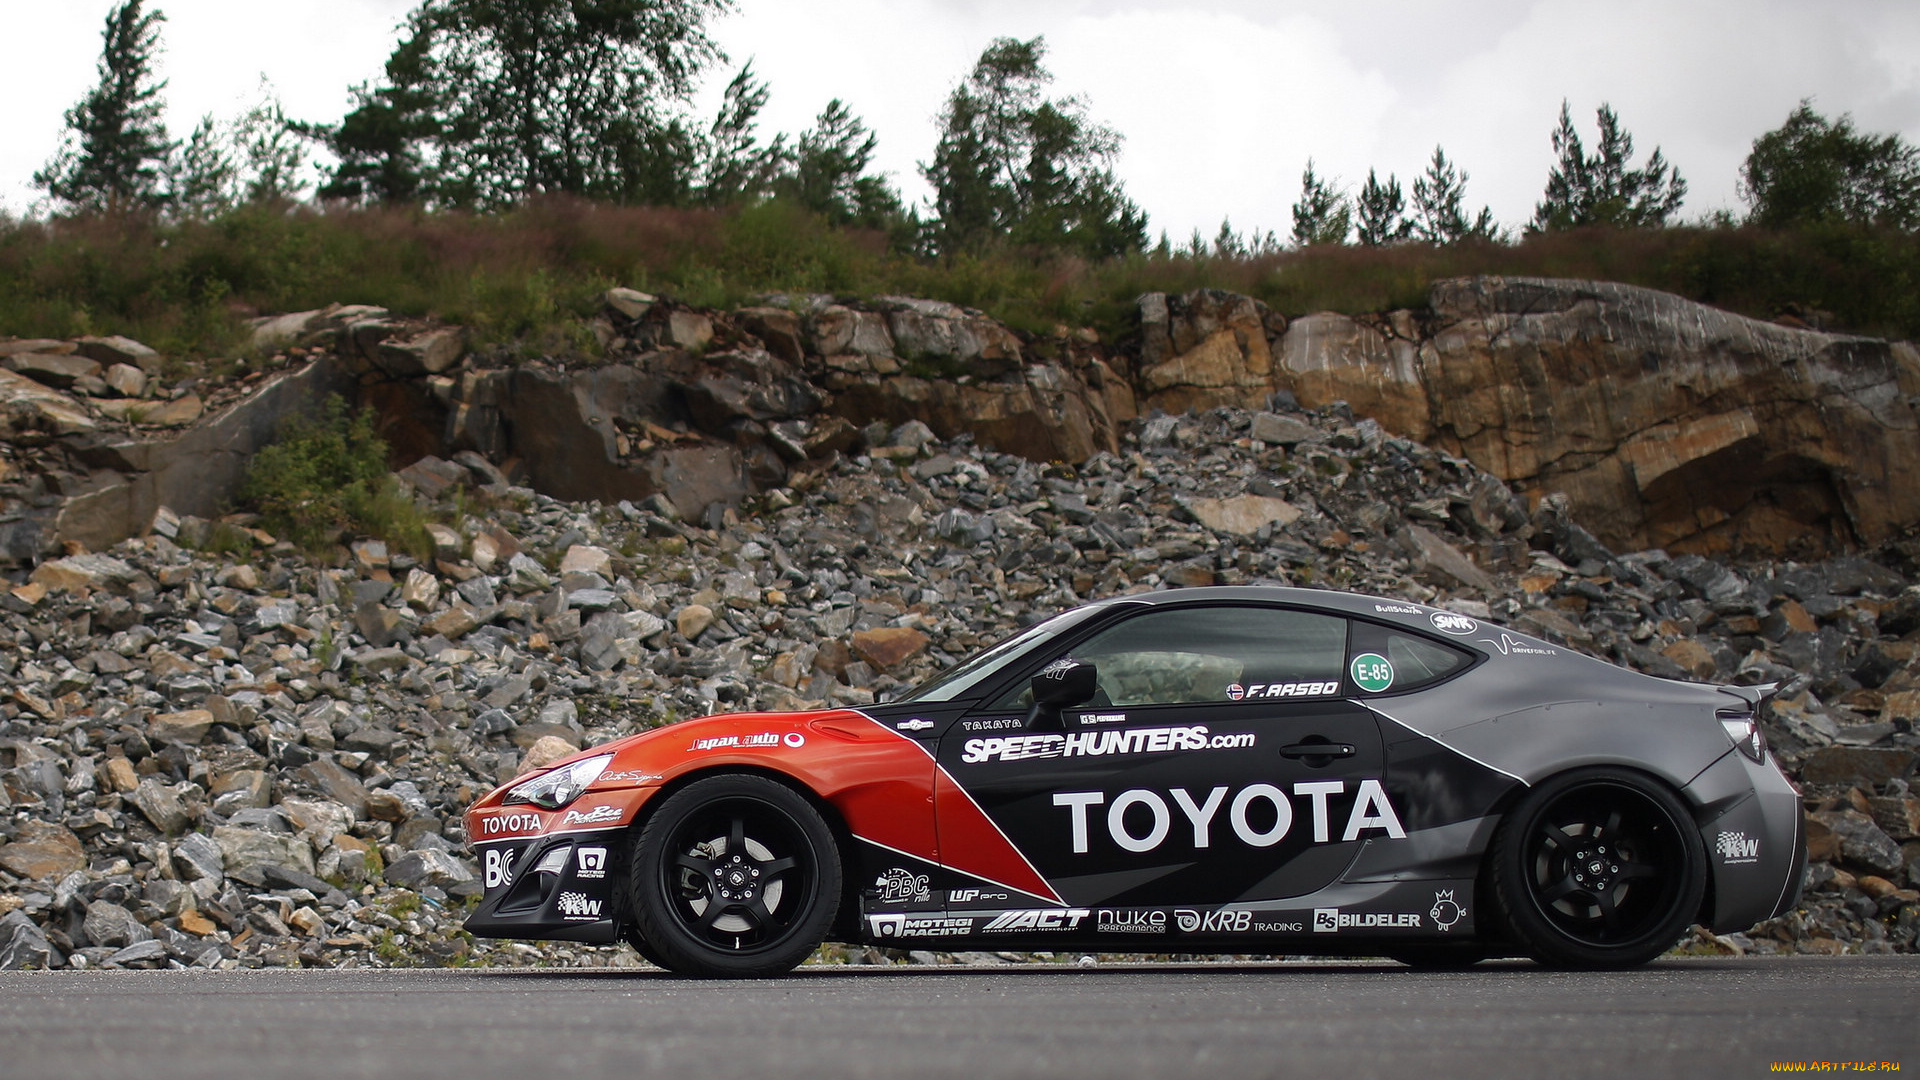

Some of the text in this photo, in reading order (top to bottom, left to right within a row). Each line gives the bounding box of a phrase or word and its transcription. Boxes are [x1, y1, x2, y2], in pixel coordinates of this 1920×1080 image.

[1434, 615, 1474, 631] SWR
[1357, 663, 1390, 681] E-85
[963, 719, 1022, 731] TAKATA
[962, 726, 1256, 764] SPEEDHUNTERS.com
[483, 814, 542, 834] TOYOTA
[1053, 780, 1408, 853] TOYOTA
[885, 875, 930, 899] PBC
[905, 918, 974, 929] MOTEGI
[1201, 911, 1303, 932] KRB TRADING
[1339, 913, 1421, 927] BILDELER
[903, 928, 971, 938] RACING
